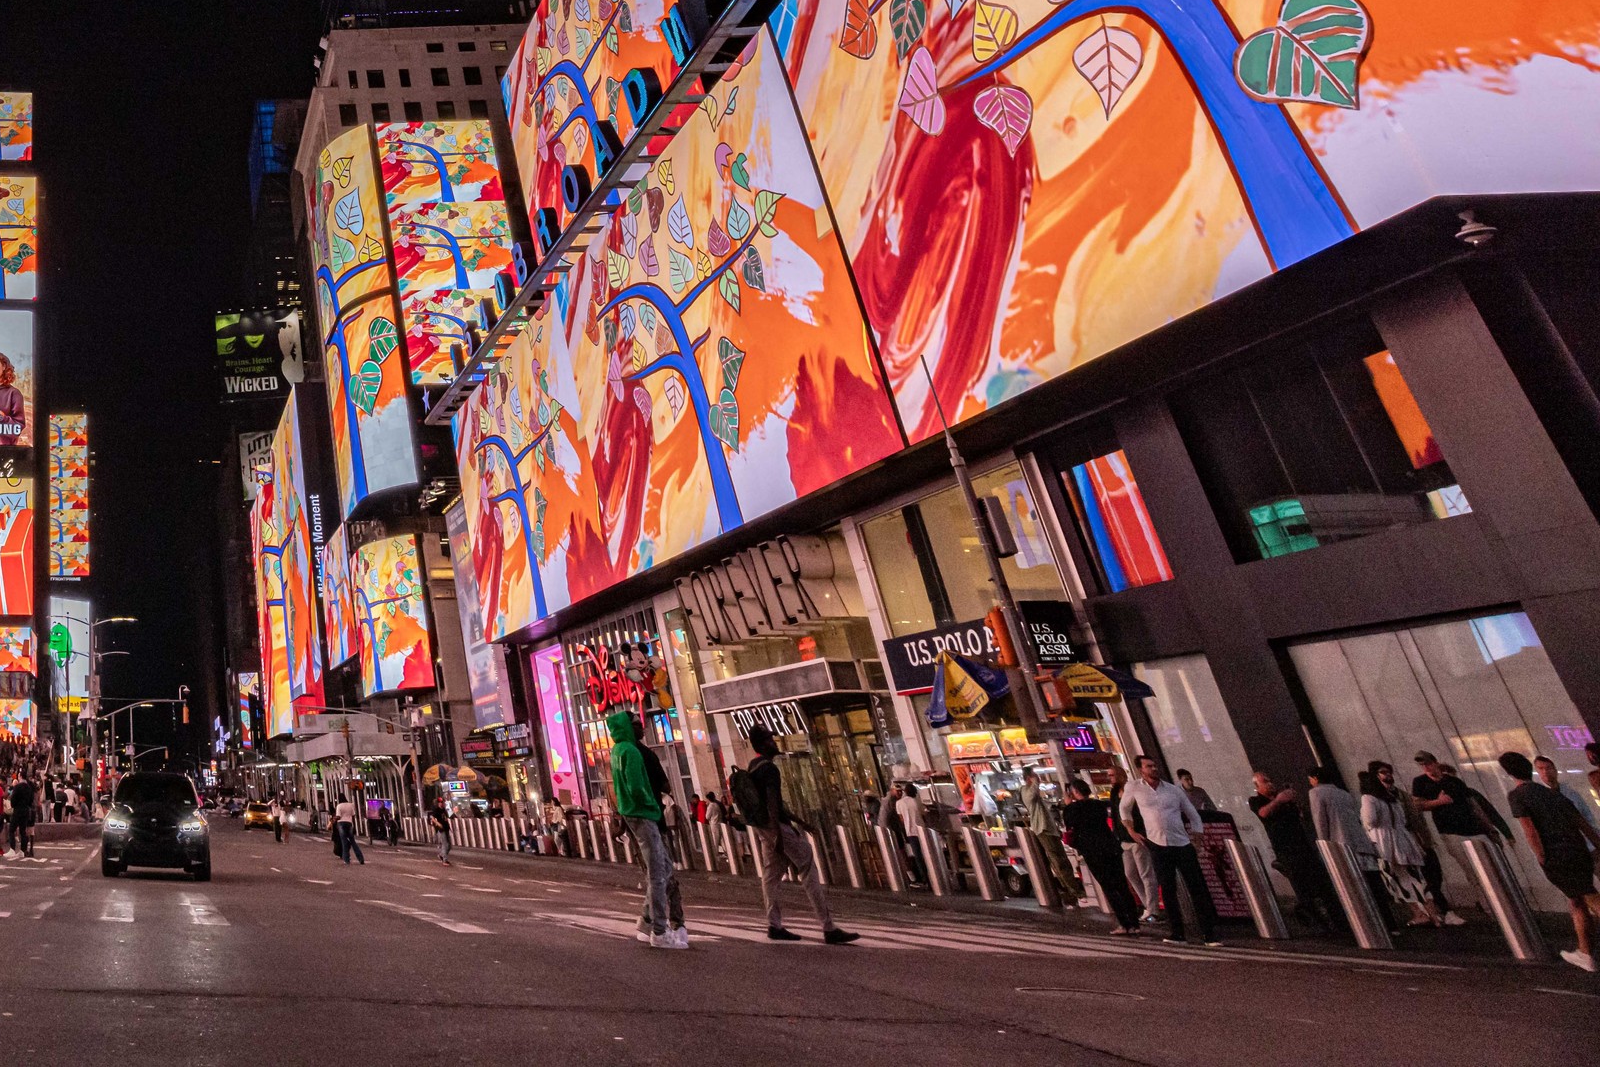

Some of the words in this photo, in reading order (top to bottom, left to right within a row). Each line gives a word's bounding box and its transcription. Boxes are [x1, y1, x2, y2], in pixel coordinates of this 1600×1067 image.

[309, 494, 324, 543] Moment
[673, 533, 822, 651] FOREVER
[1030, 623, 1054, 634] U.S.
[1033, 634, 1067, 644] POLO
[904, 640, 935, 666] U.S.
[934, 629, 982, 658] POLO
[983, 626, 1000, 653] A
[1039, 645, 1075, 655] ASSN.
[576, 644, 645, 729] Disney
[1071, 684, 1113, 694] ABRETT
[951, 693, 988, 715] SABRETT
